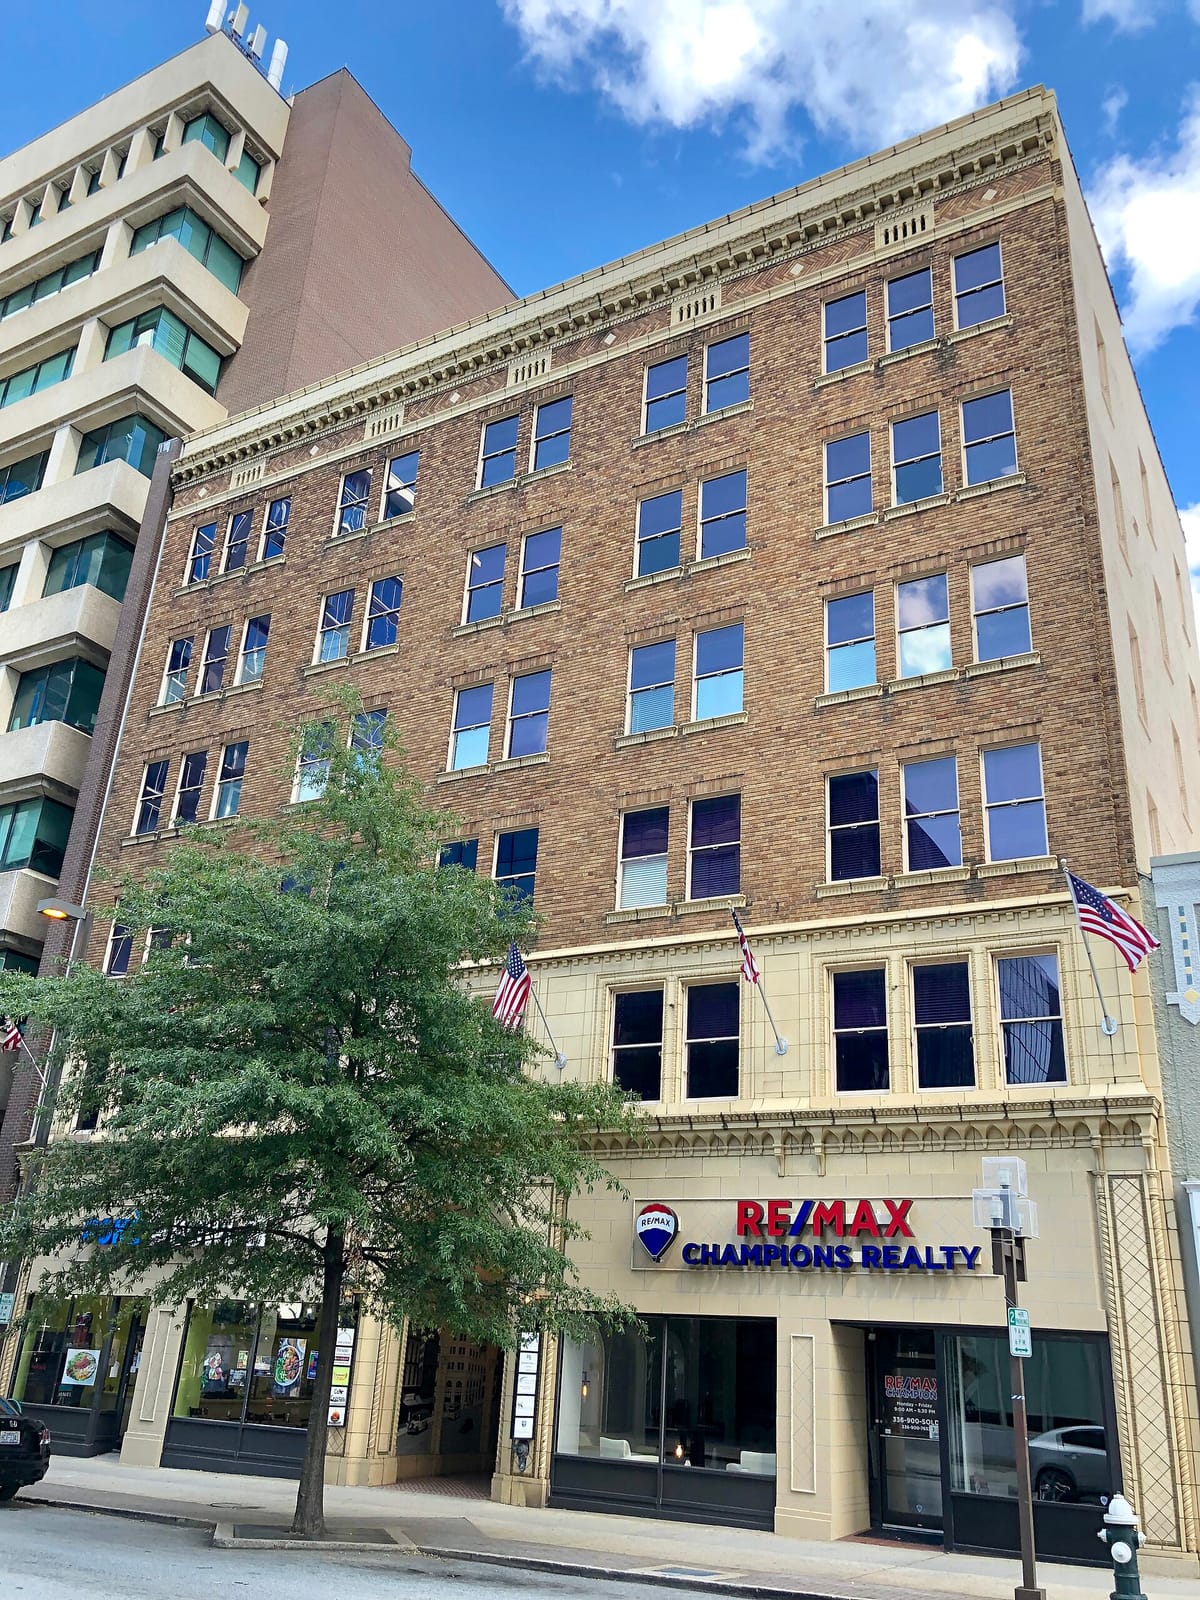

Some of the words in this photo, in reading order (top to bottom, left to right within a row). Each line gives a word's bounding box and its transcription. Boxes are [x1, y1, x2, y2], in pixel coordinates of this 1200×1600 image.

[641, 1217, 670, 1227] RE/MAX
[737, 1199, 915, 1238] RE/MAX
[682, 1243, 853, 1268] CHAMPIONS
[861, 1245, 982, 1270] REALTY
[1010, 1311, 1015, 1323] 2
[884, 1375, 938, 1392] RE/MAX
